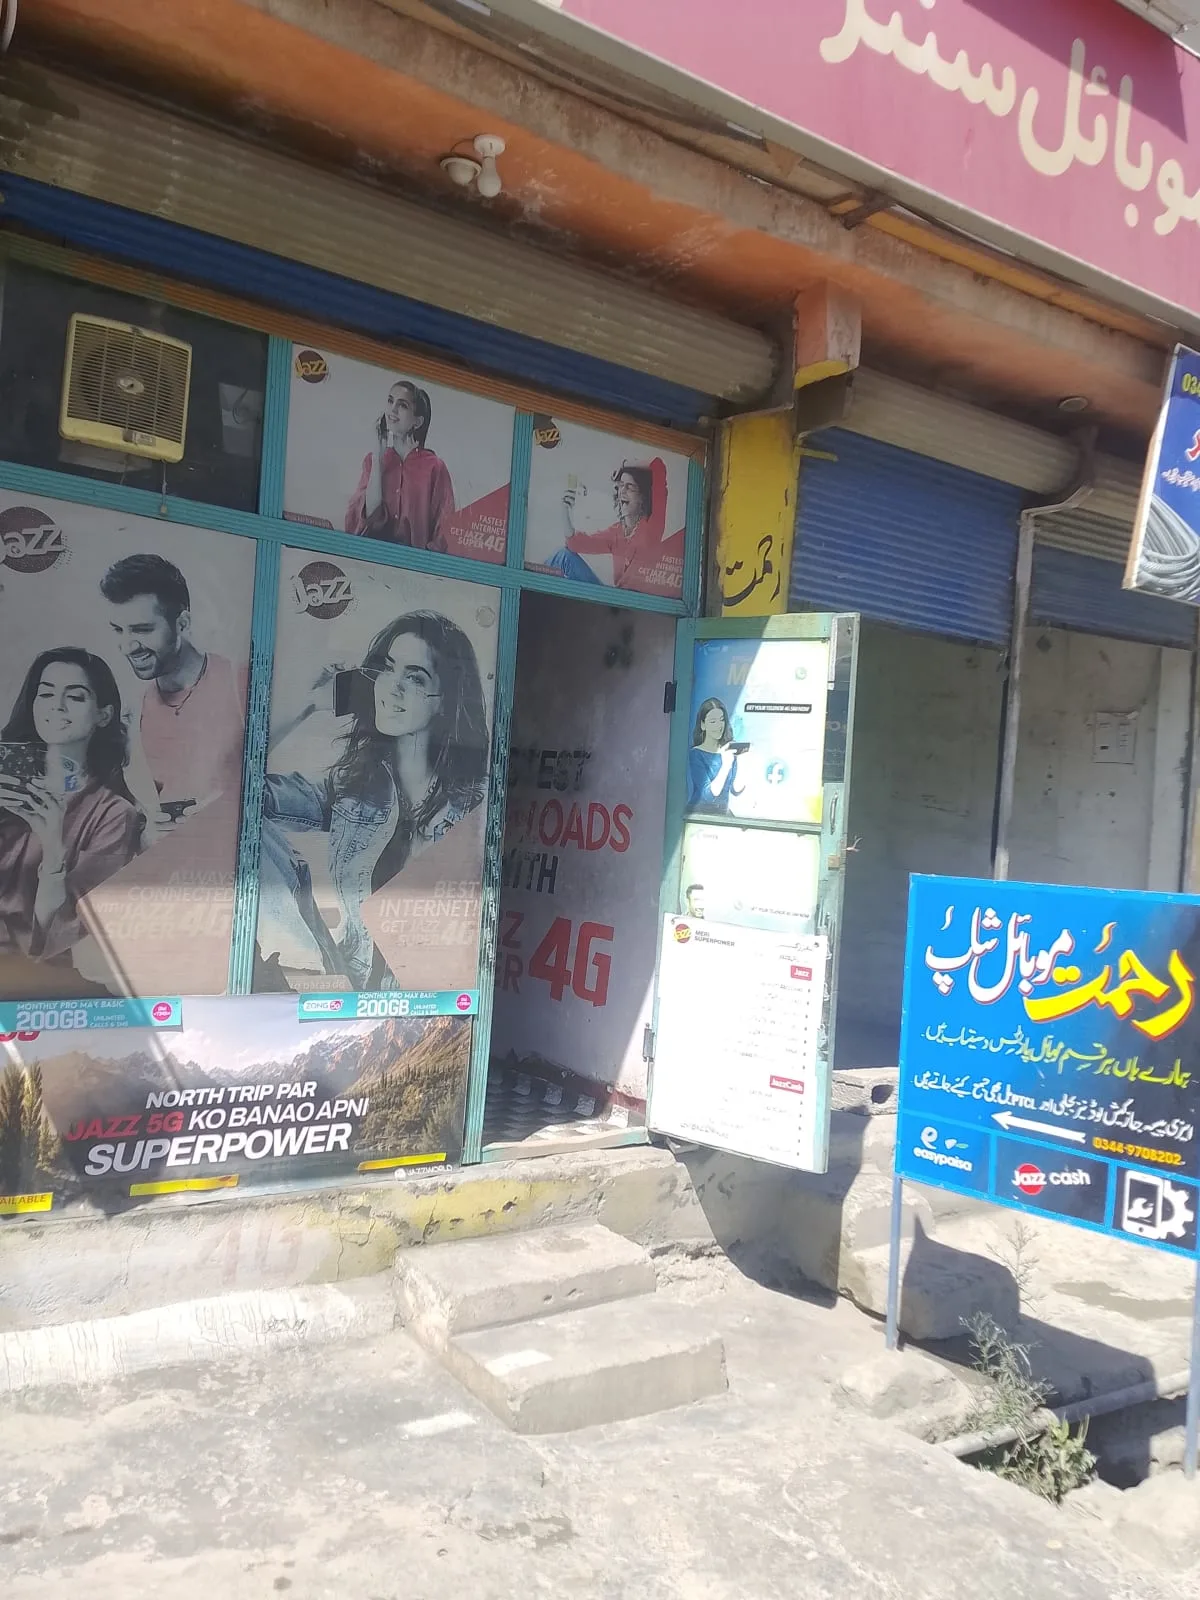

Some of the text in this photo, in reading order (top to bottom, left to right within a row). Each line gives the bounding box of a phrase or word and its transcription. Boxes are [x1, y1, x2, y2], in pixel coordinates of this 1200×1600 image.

[0, 524, 67, 565] azz
[484, 535, 506, 552] 4G
[292, 573, 354, 614] Jazz
[433, 880, 480, 898] BEST
[528, 916, 615, 1007] 4G
[924, 905, 1196, 1041] رحمت موبائل شاپ
[17, 1002, 58, 1011] MONTHLY
[100, 1000, 125, 1008] BASIC
[304, 1002, 329, 1010] ZONG
[357, 992, 388, 1000] MONTHLY
[356, 998, 410, 1017] 200GB
[15, 1009, 88, 1031] 200GB
[146, 1081, 318, 1109] NORTH TRIP PAR
[1010, 1094, 1038, 1110] PTCL
[66, 1097, 370, 1142] JAZZ 5G KO BANAO APNI
[84, 1122, 353, 1177] SUPERPOWER
[913, 1146, 973, 1172] easypaisa
[1012, 1168, 1092, 1187] Jazz cash
